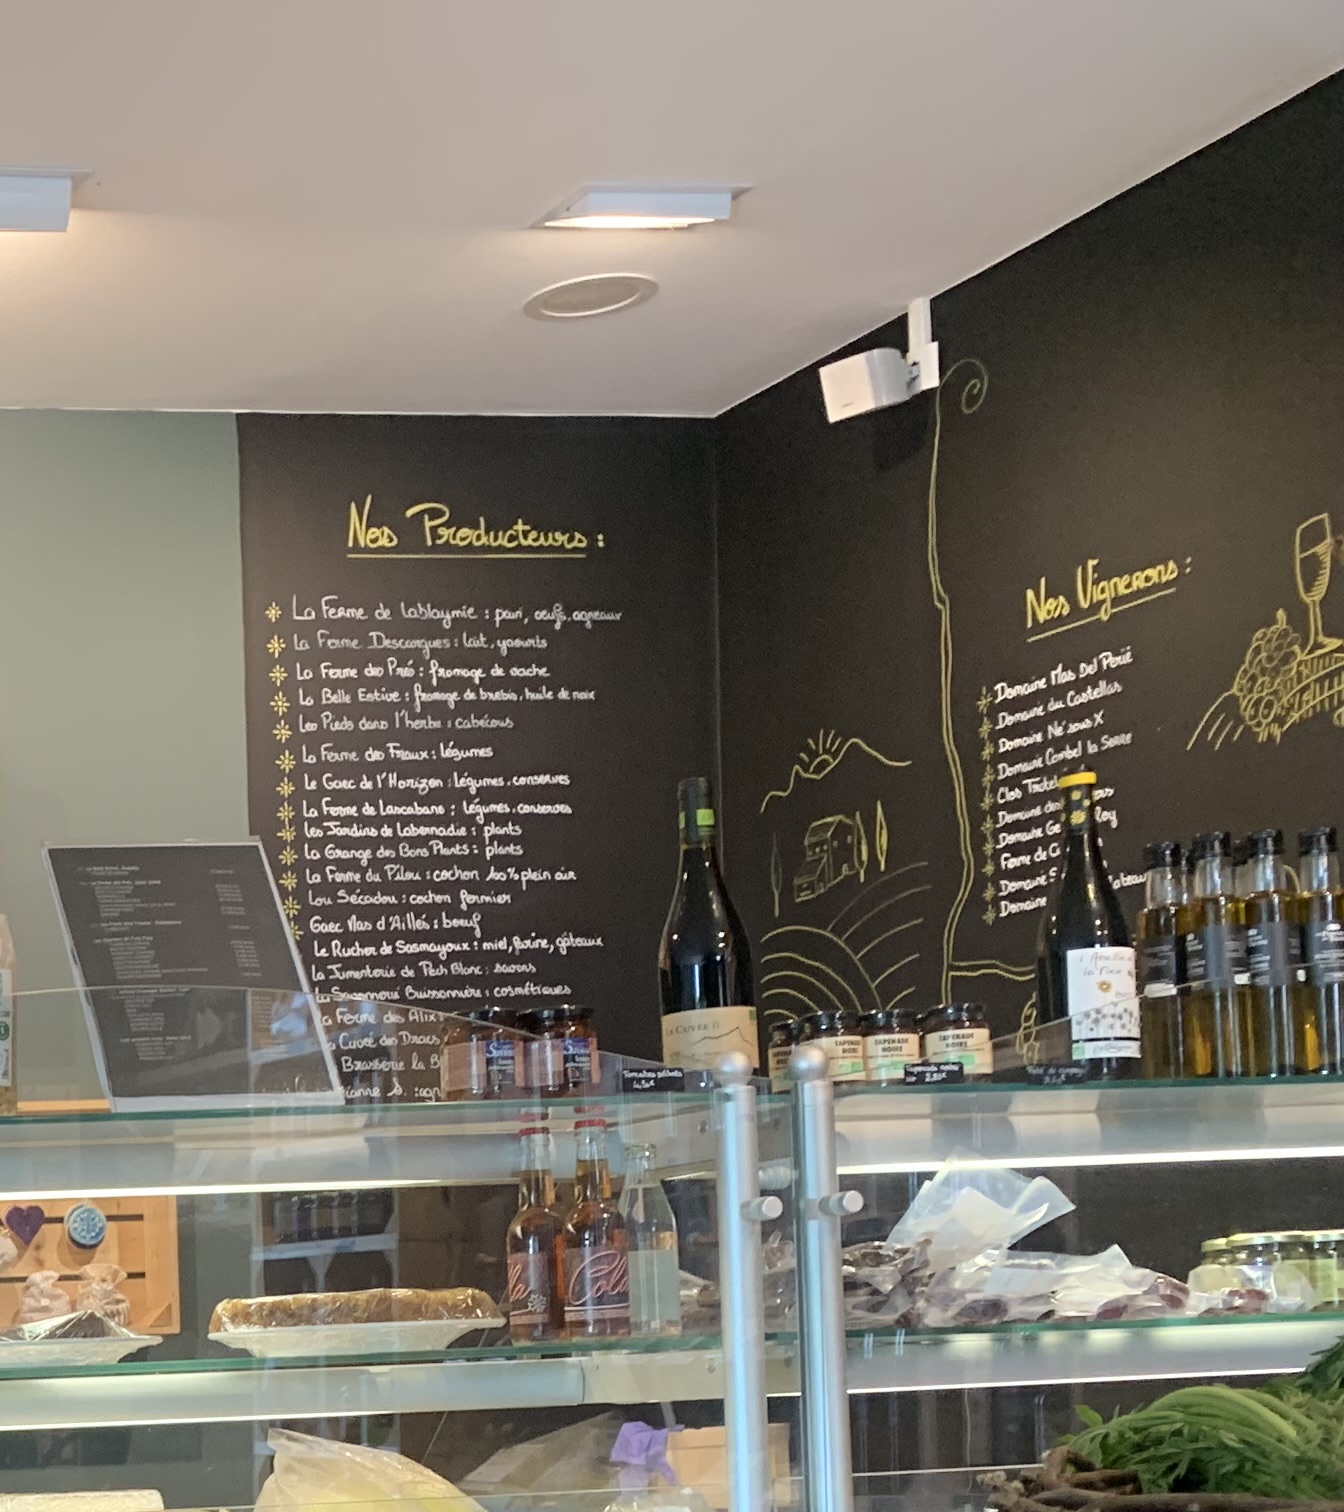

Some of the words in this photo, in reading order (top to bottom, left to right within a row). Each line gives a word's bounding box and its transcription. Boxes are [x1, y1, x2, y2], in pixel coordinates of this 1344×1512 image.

[346, 493, 398, 549] Nos
[405, 502, 588, 549] Producteurs
[1025, 578, 1070, 628] Nos
[1076, 558, 1179, 622] Vignerons
[292, 594, 315, 620] La
[321, 595, 368, 619] Ferme
[375, 602, 392, 620] de
[317, 630, 361, 649] Ferme
[296, 662, 313, 680] La
[320, 662, 358, 679] Ferme
[364, 662, 383, 677] des
[429, 659, 486, 687] fromage
[490, 663, 505, 677] de
[509, 663, 551, 677] vache
[994, 677, 1047, 703] Domaine
[1051, 664, 1076, 687] Mas
[1079, 658, 1097, 678] Del
[299, 688, 314, 706] La
[321, 688, 351, 704] Belle
[357, 686, 401, 702] Estive
[413, 683, 460, 712] fromage
[463, 688, 478, 701] de
[525, 685, 554, 700] huile
[558, 686, 571, 700] de
[572, 689, 596, 701] noix
[298, 714, 318, 732] Les
[320, 711, 354, 731] Pieds
[359, 716, 388, 730] dans
[995, 706, 1045, 730] Domaine
[1048, 697, 1065, 711] du
[998, 728, 1044, 753] Domaine
[302, 744, 317, 764] La
[321, 743, 359, 762] Ferme
[365, 747, 385, 761] des
[997, 757, 1044, 780] Domaine
[1087, 740, 1099, 754] la
[304, 773, 317, 790] Le
[322, 773, 356, 790] Gaec
[360, 774, 373, 790] de
[377, 772, 444, 795] l'Horizon
[512, 774, 571, 786] conserves
[997, 785, 1022, 804] Clos
[302, 800, 318, 818] La
[322, 797, 359, 816] Ferme
[362, 802, 377, 816] de
[996, 806, 1043, 829] Domaine
[304, 822, 323, 838] Les
[323, 822, 378, 837] Jardins
[380, 823, 393, 837] de
[483, 822, 522, 845] plants
[996, 825, 1043, 849] Domaine
[304, 843, 321, 860] La
[324, 844, 372, 866] Grange
[376, 845, 396, 858] des
[399, 842, 429, 857] Bons
[486, 841, 523, 860] plants
[1034, 847, 1046, 862] de
[306, 868, 321, 884] La
[325, 866, 362, 883] Ferme
[365, 867, 382, 883] du
[433, 864, 479, 882] cochon
[520, 867, 551, 891] plein
[555, 867, 577, 881] air
[1000, 873, 1048, 896] Domaine
[308, 890, 332, 906] Lou
[409, 890, 451, 904] cochon
[460, 889, 512, 910] fermier
[1000, 896, 1047, 918] Domaine
[309, 916, 344, 933] Gaec
[348, 915, 372, 931] Mas
[314, 940, 329, 957] Le
[331, 940, 377, 957] Rucher
[379, 941, 393, 955] de
[312, 964, 325, 981] La
[327, 963, 397, 980] Jumenterie
[400, 965, 415, 978] de
[418, 960, 448, 977] Pech
[450, 962, 482, 975] Blanc
[336, 1007, 376, 1025] Ferme
[383, 1011, 405, 1024] des
[379, 1036, 398, 1046] des
[412, 1052, 425, 1070] la
